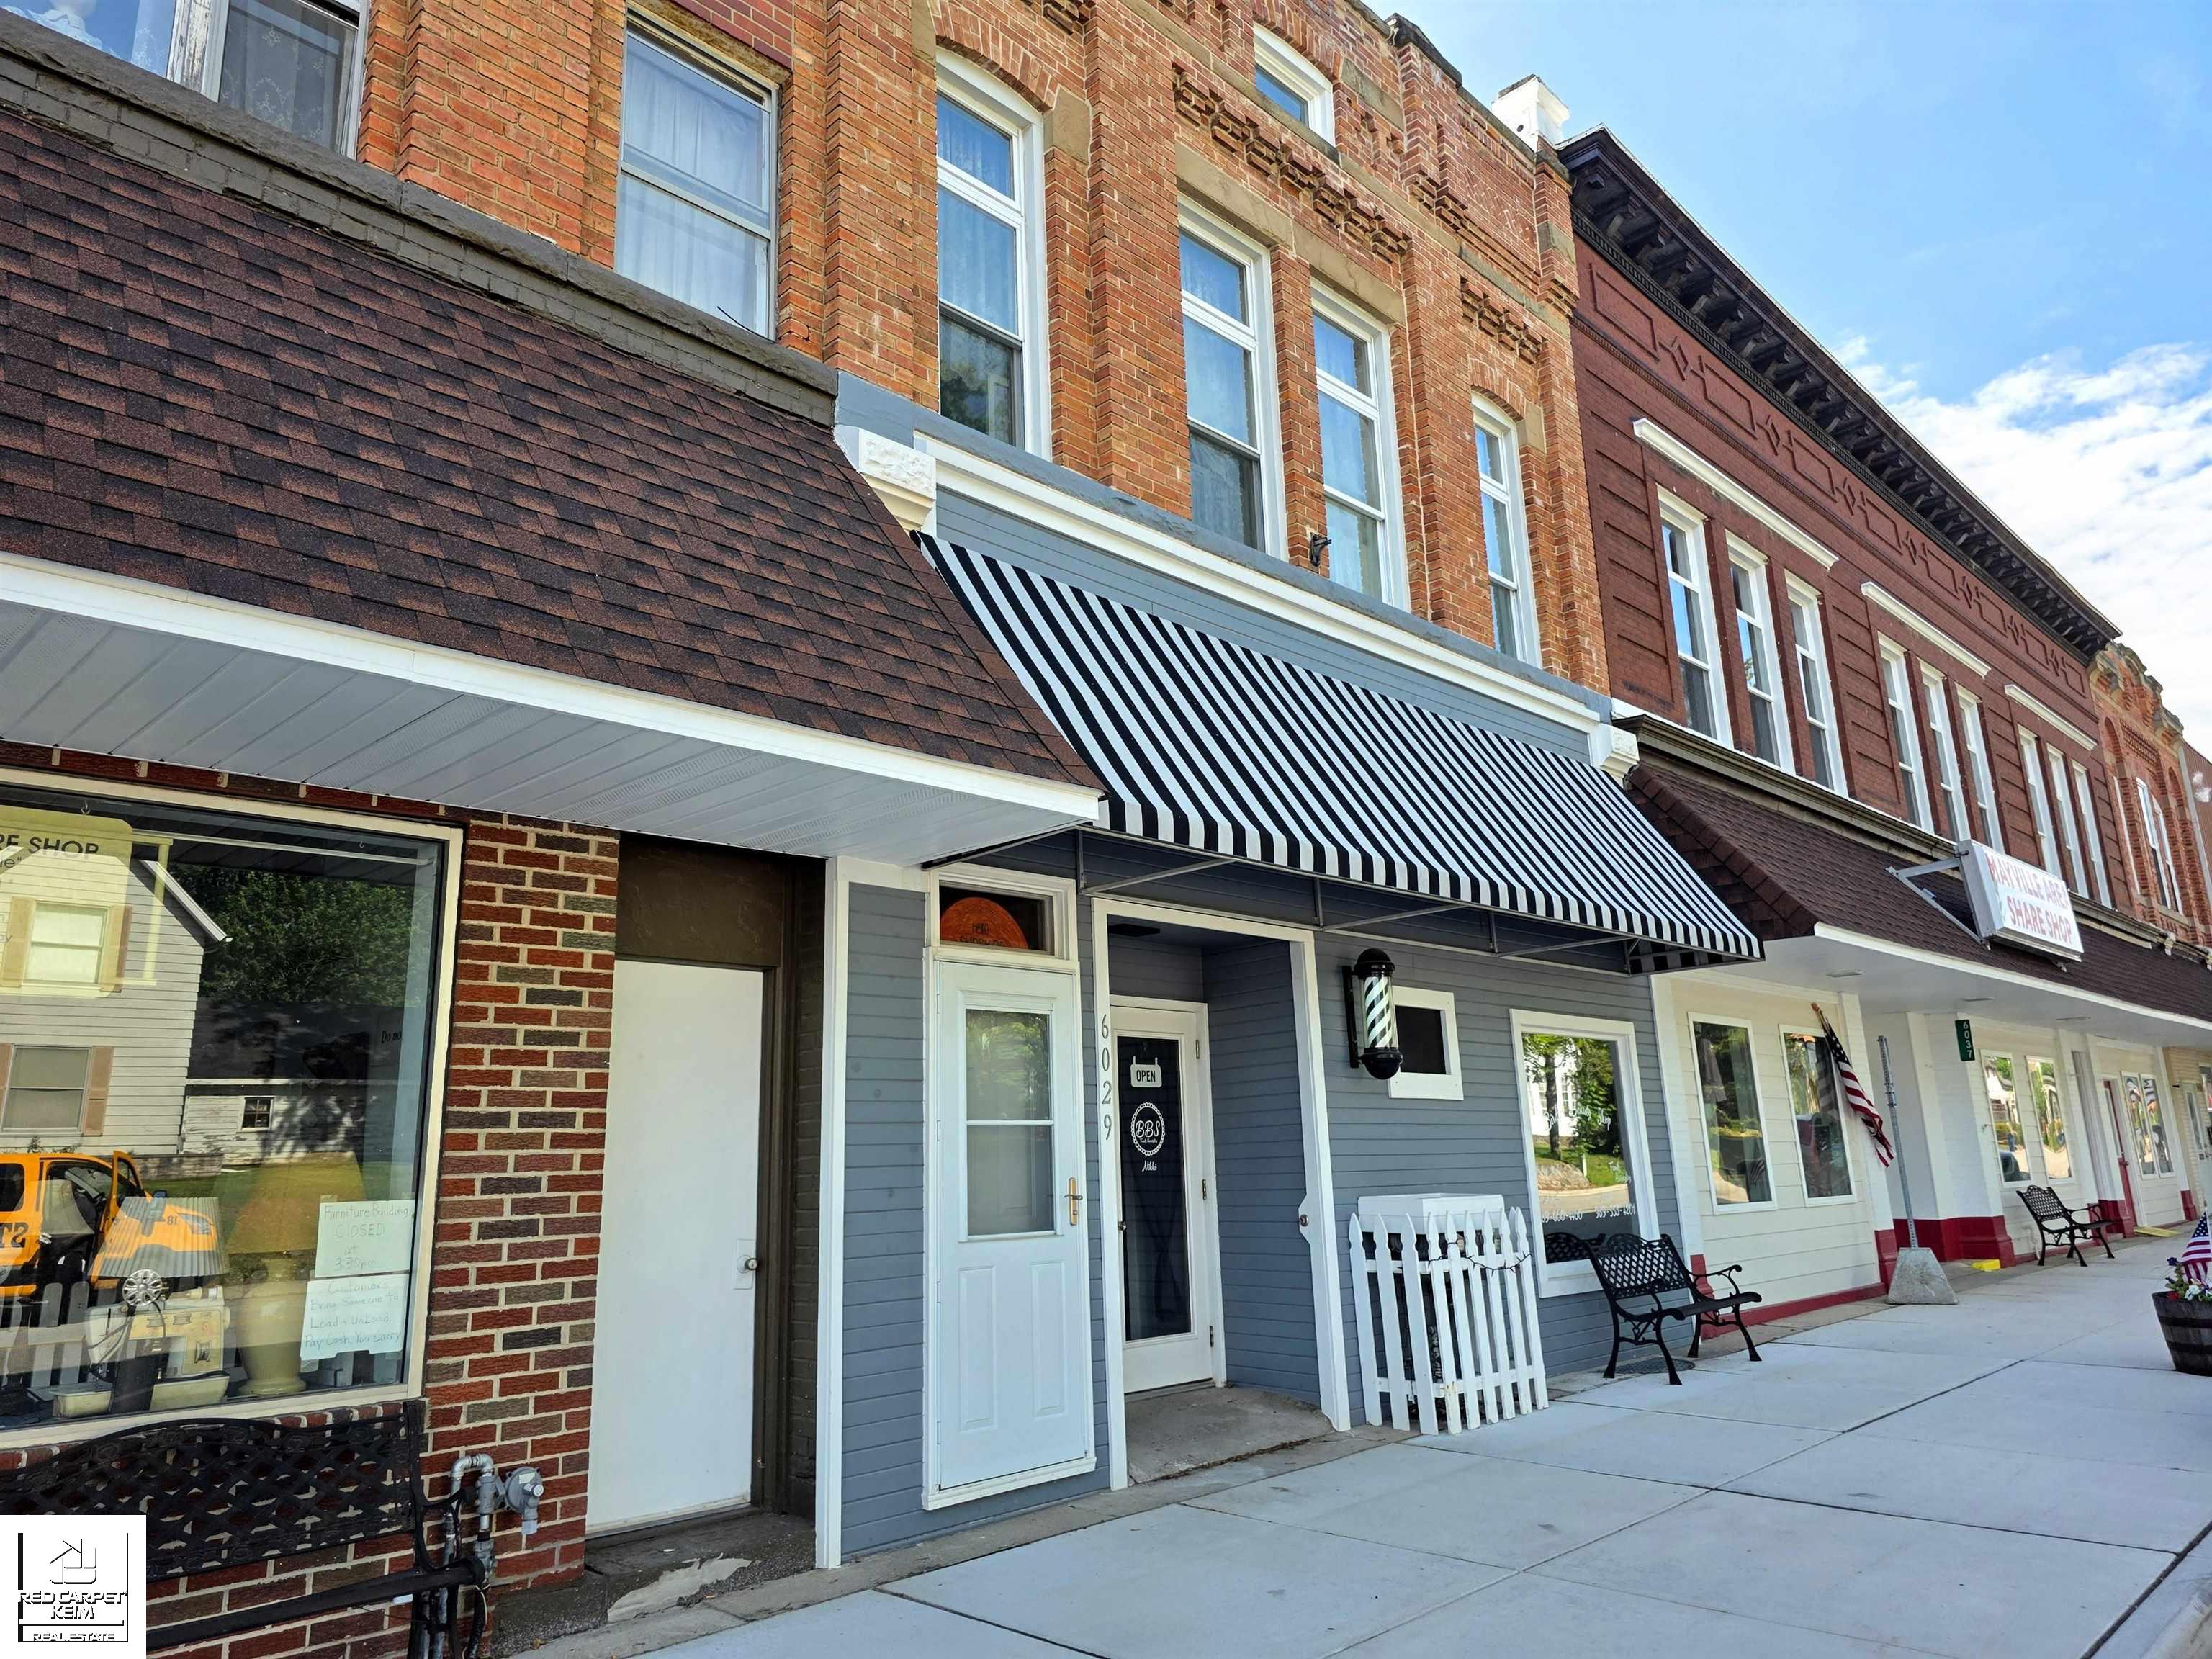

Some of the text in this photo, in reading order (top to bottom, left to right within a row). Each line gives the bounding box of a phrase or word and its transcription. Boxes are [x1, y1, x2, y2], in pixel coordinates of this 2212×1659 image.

[27, 836, 99, 860] SHOP
[1985, 851, 2046, 901] MAYVILLE
[2006, 895, 2072, 945] SHARE SHOP
[1963, 1020, 1973, 1058] 6037
[1101, 1014, 1112, 1141] 6029
[1136, 1069, 1156, 1083] OPEN
[1136, 1120, 1161, 1138] BBS
[324, 1202, 409, 1220] Furniture Building
[305, 1334, 323, 1351] Pay
